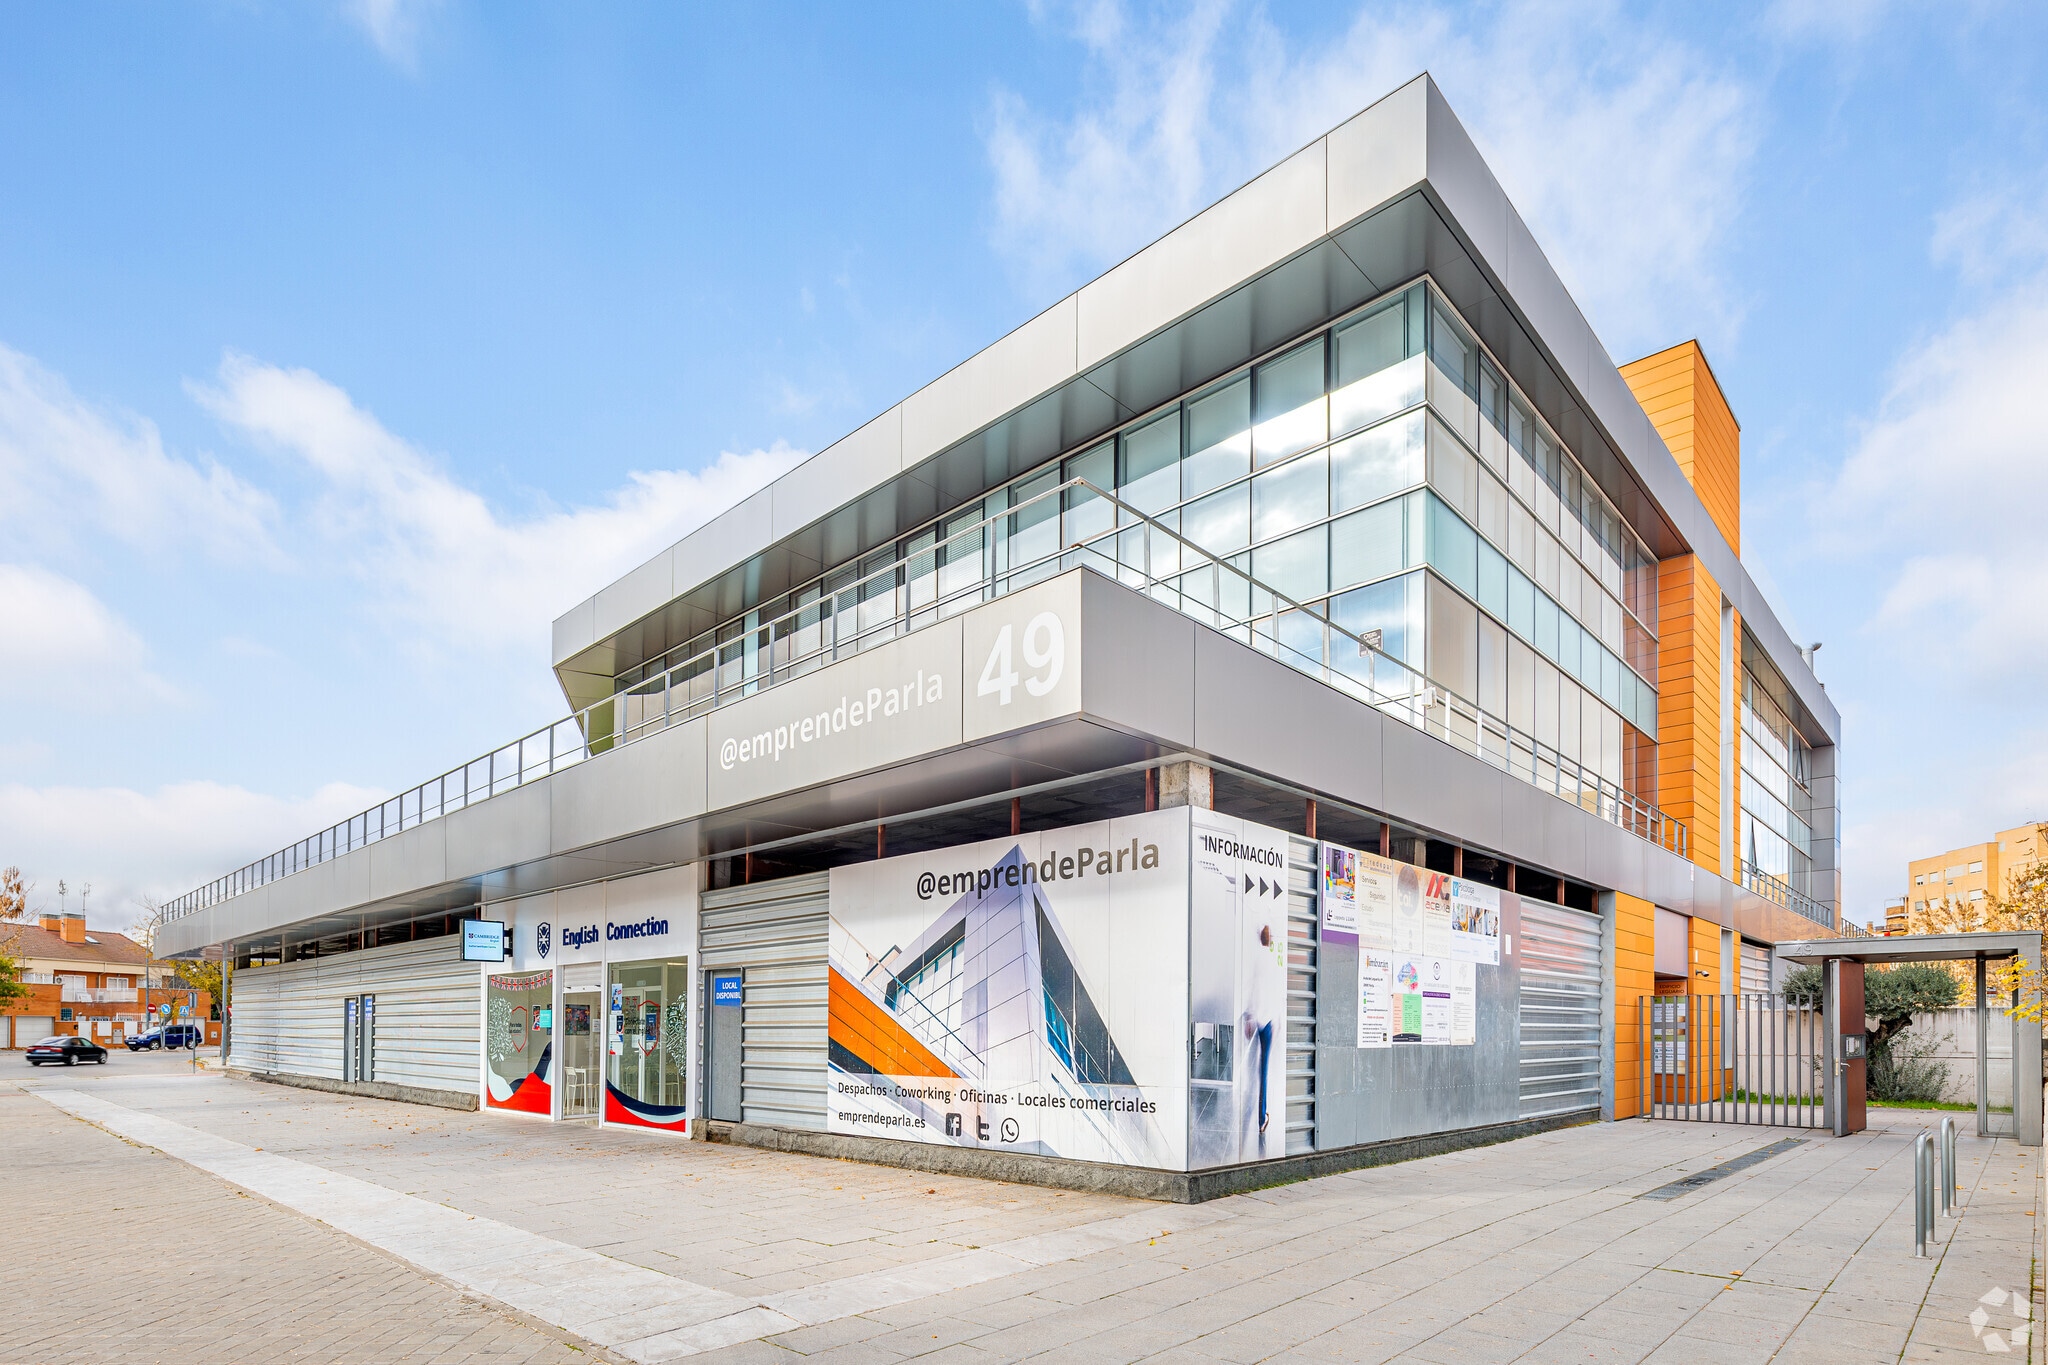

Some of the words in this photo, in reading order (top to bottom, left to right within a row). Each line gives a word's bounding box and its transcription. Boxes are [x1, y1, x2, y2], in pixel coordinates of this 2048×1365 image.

[977, 611, 1065, 706] 49
[719, 669, 943, 770] @emprendeParla
[1204, 834, 1283, 869] INFORMACIÓN
[916, 837, 1159, 900] @emprendeParla
[562, 925, 599, 950] English
[606, 916, 668, 941] Connection
[1792, 943, 1813, 957] 49
[715, 991, 742, 1000] DISPONIBL
[722, 981, 738, 990] LOCAL
[838, 1082, 887, 1097] Despachos
[894, 1085, 951, 1104] Coworking
[960, 1089, 1008, 1105] Oficinas
[1017, 1092, 1066, 1108] Locales
[1070, 1096, 1156, 1113] comerciales
[838, 1110, 926, 1128] emprendeparla.es
